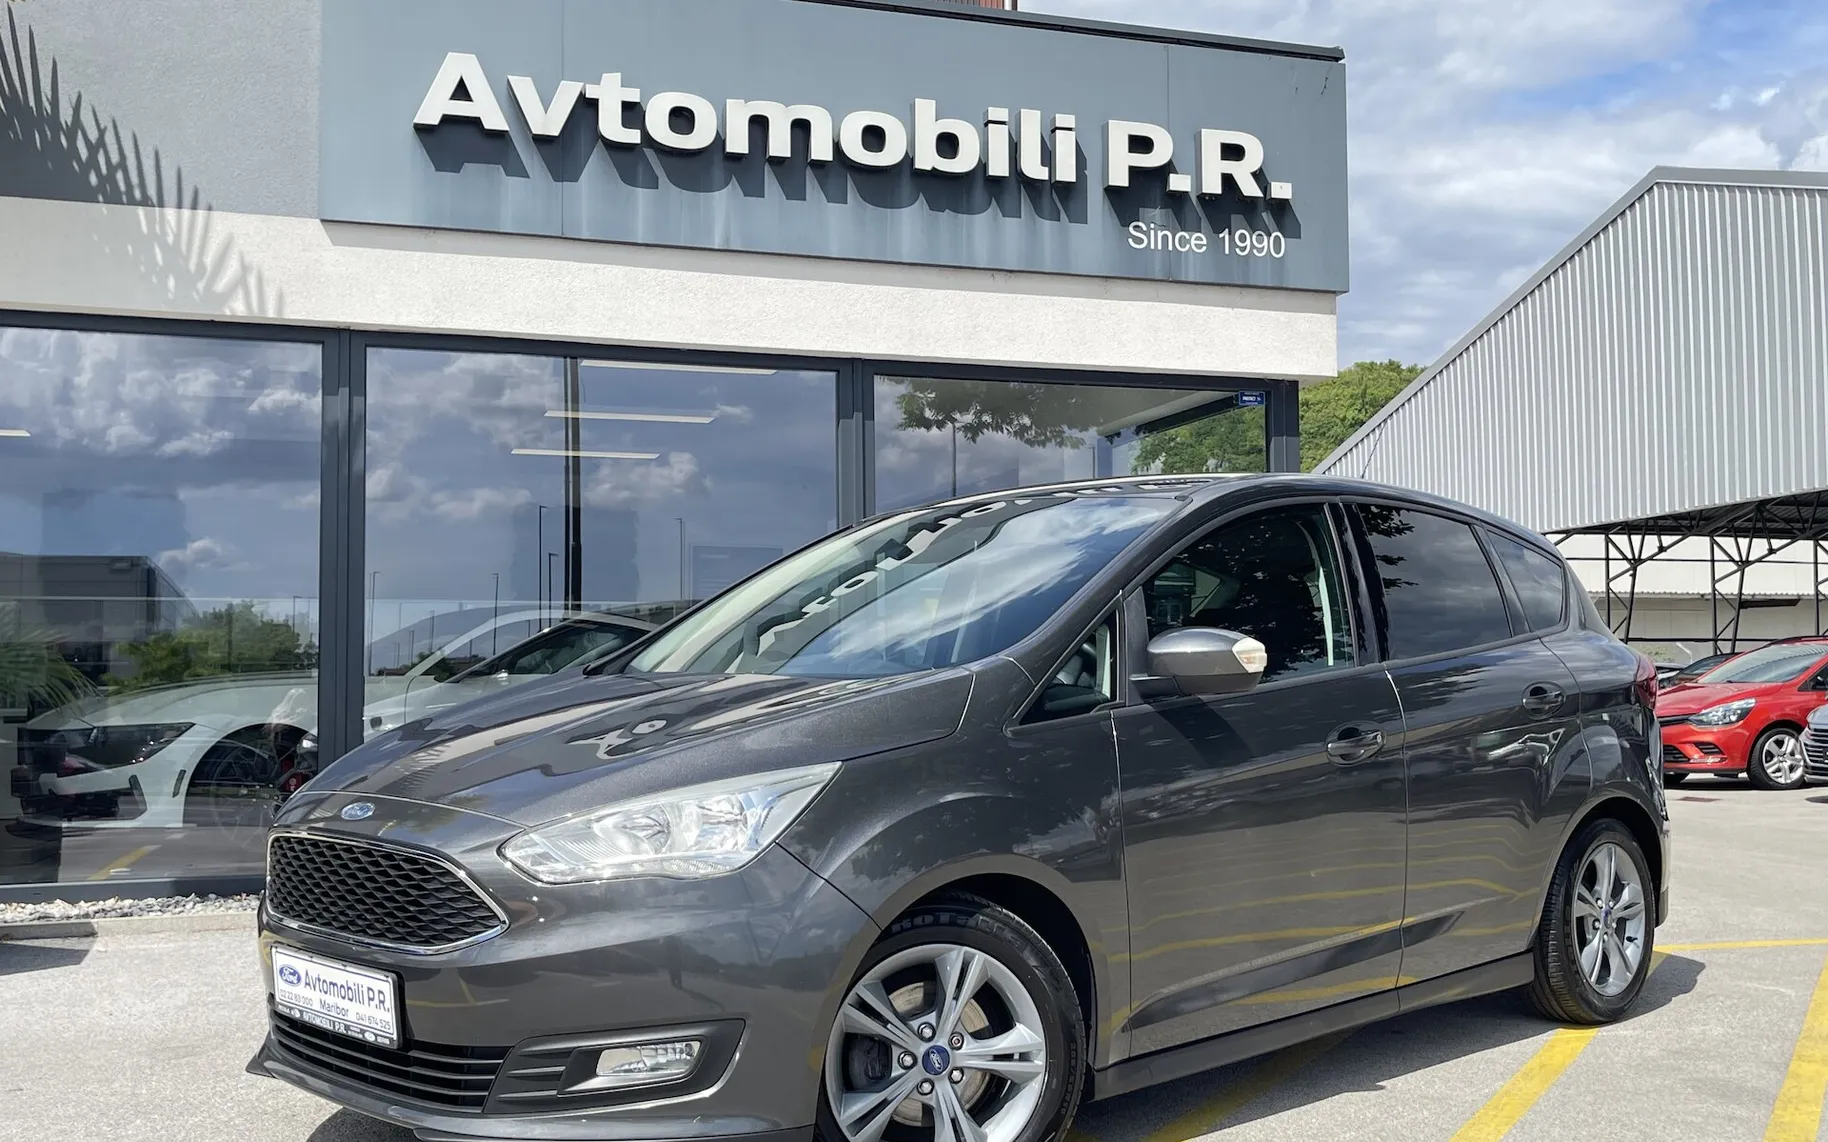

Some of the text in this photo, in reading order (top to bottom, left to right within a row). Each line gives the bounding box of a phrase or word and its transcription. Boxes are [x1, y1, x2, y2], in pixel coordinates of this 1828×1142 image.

[412, 52, 1293, 201] Avtomobili P.R.
[1128, 221, 1285, 258] Since 1990
[304, 968, 391, 1013] Avtomobili P.R.
[320, 999, 349, 1018] Maribor
[356, 1011, 367, 1023] 041
[368, 1015, 379, 1026] 674
